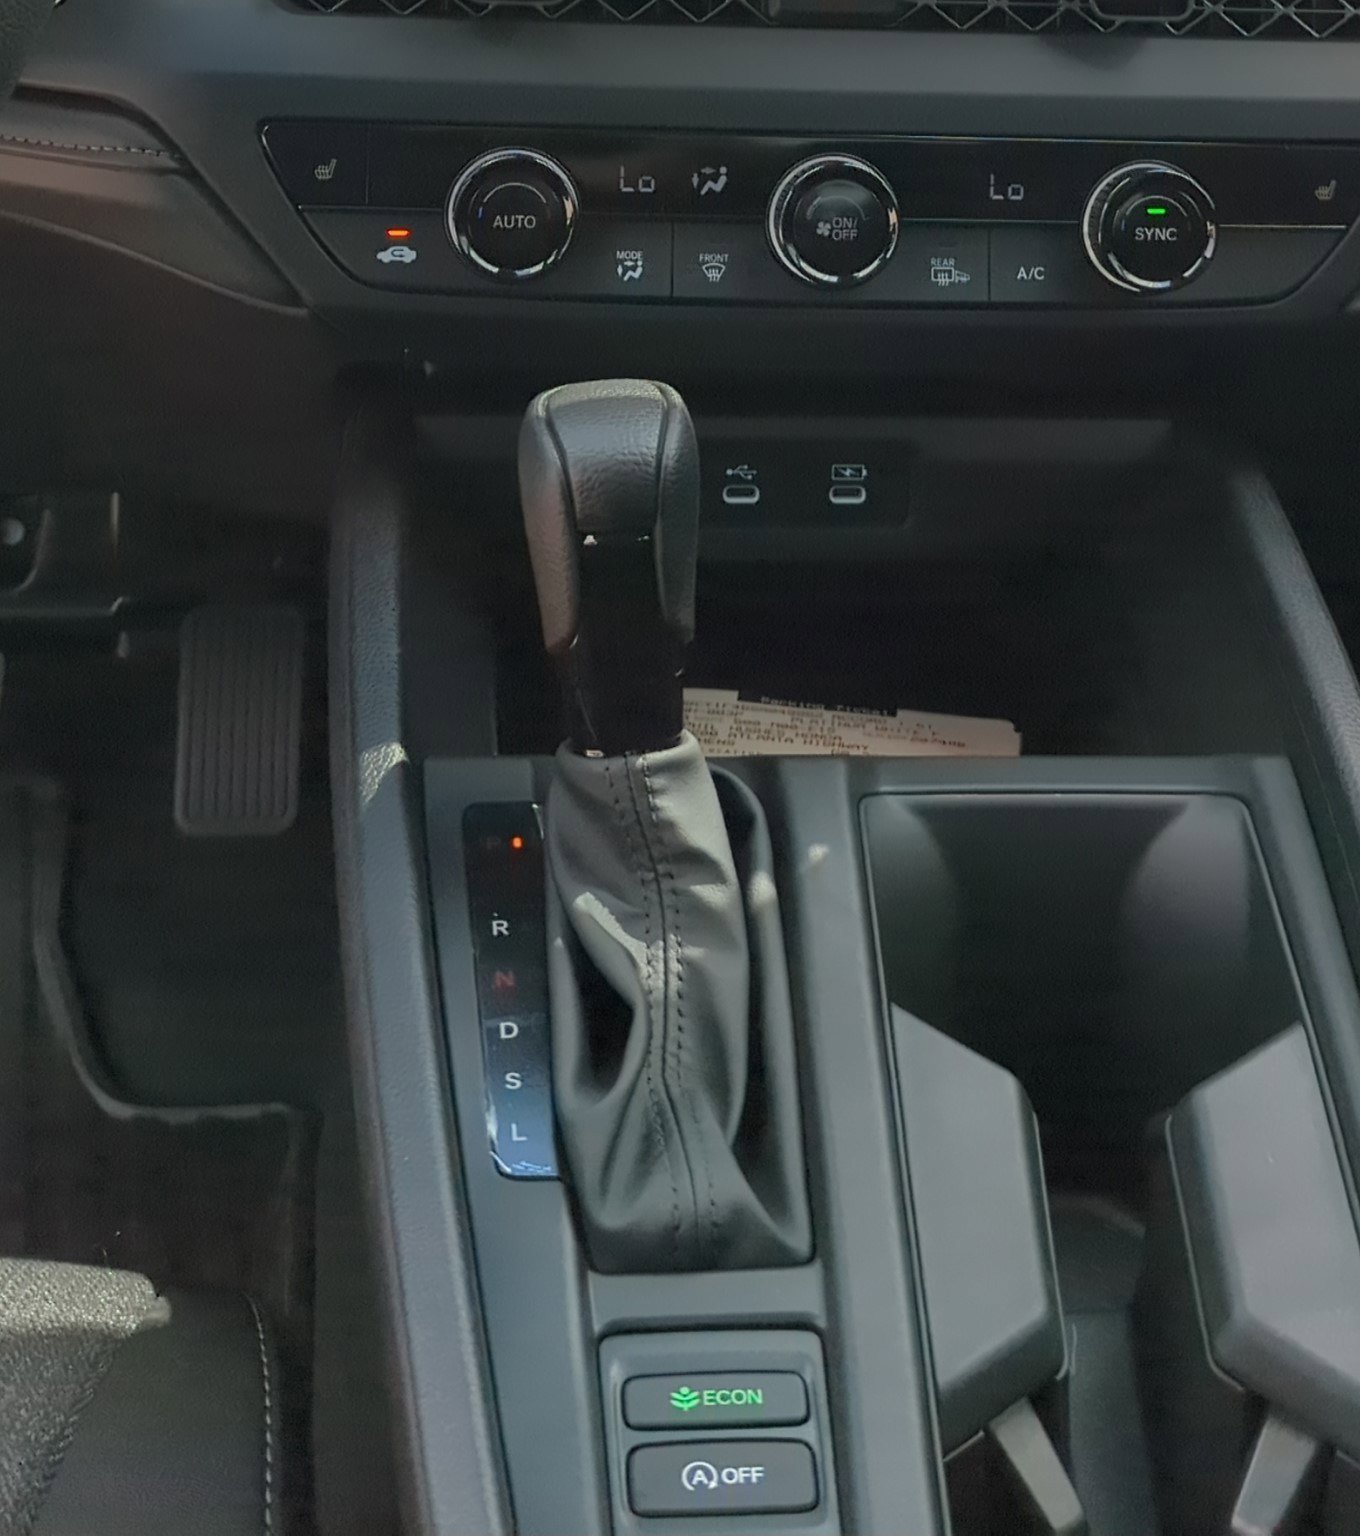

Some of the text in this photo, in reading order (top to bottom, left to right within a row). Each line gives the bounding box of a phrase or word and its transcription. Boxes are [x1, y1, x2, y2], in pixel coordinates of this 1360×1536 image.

[618, 165, 657, 194] Lo
[989, 173, 1025, 202] Lo
[492, 214, 537, 230] AUTO
[831, 216, 859, 230] ON/
[831, 229, 858, 242] OFF
[1133, 227, 1178, 242] SYNC
[616, 250, 644, 261] MODE
[698, 253, 730, 263] FRONT
[930, 258, 956, 268] REAR
[1016, 266, 1046, 282] A/C
[491, 919, 510, 937] R
[493, 971, 516, 988] N
[498, 1021, 519, 1040] D
[504, 1072, 523, 1090] S
[510, 1122, 528, 1142] L
[702, 1389, 763, 1407] ECON
[721, 1466, 765, 1485] OFF
